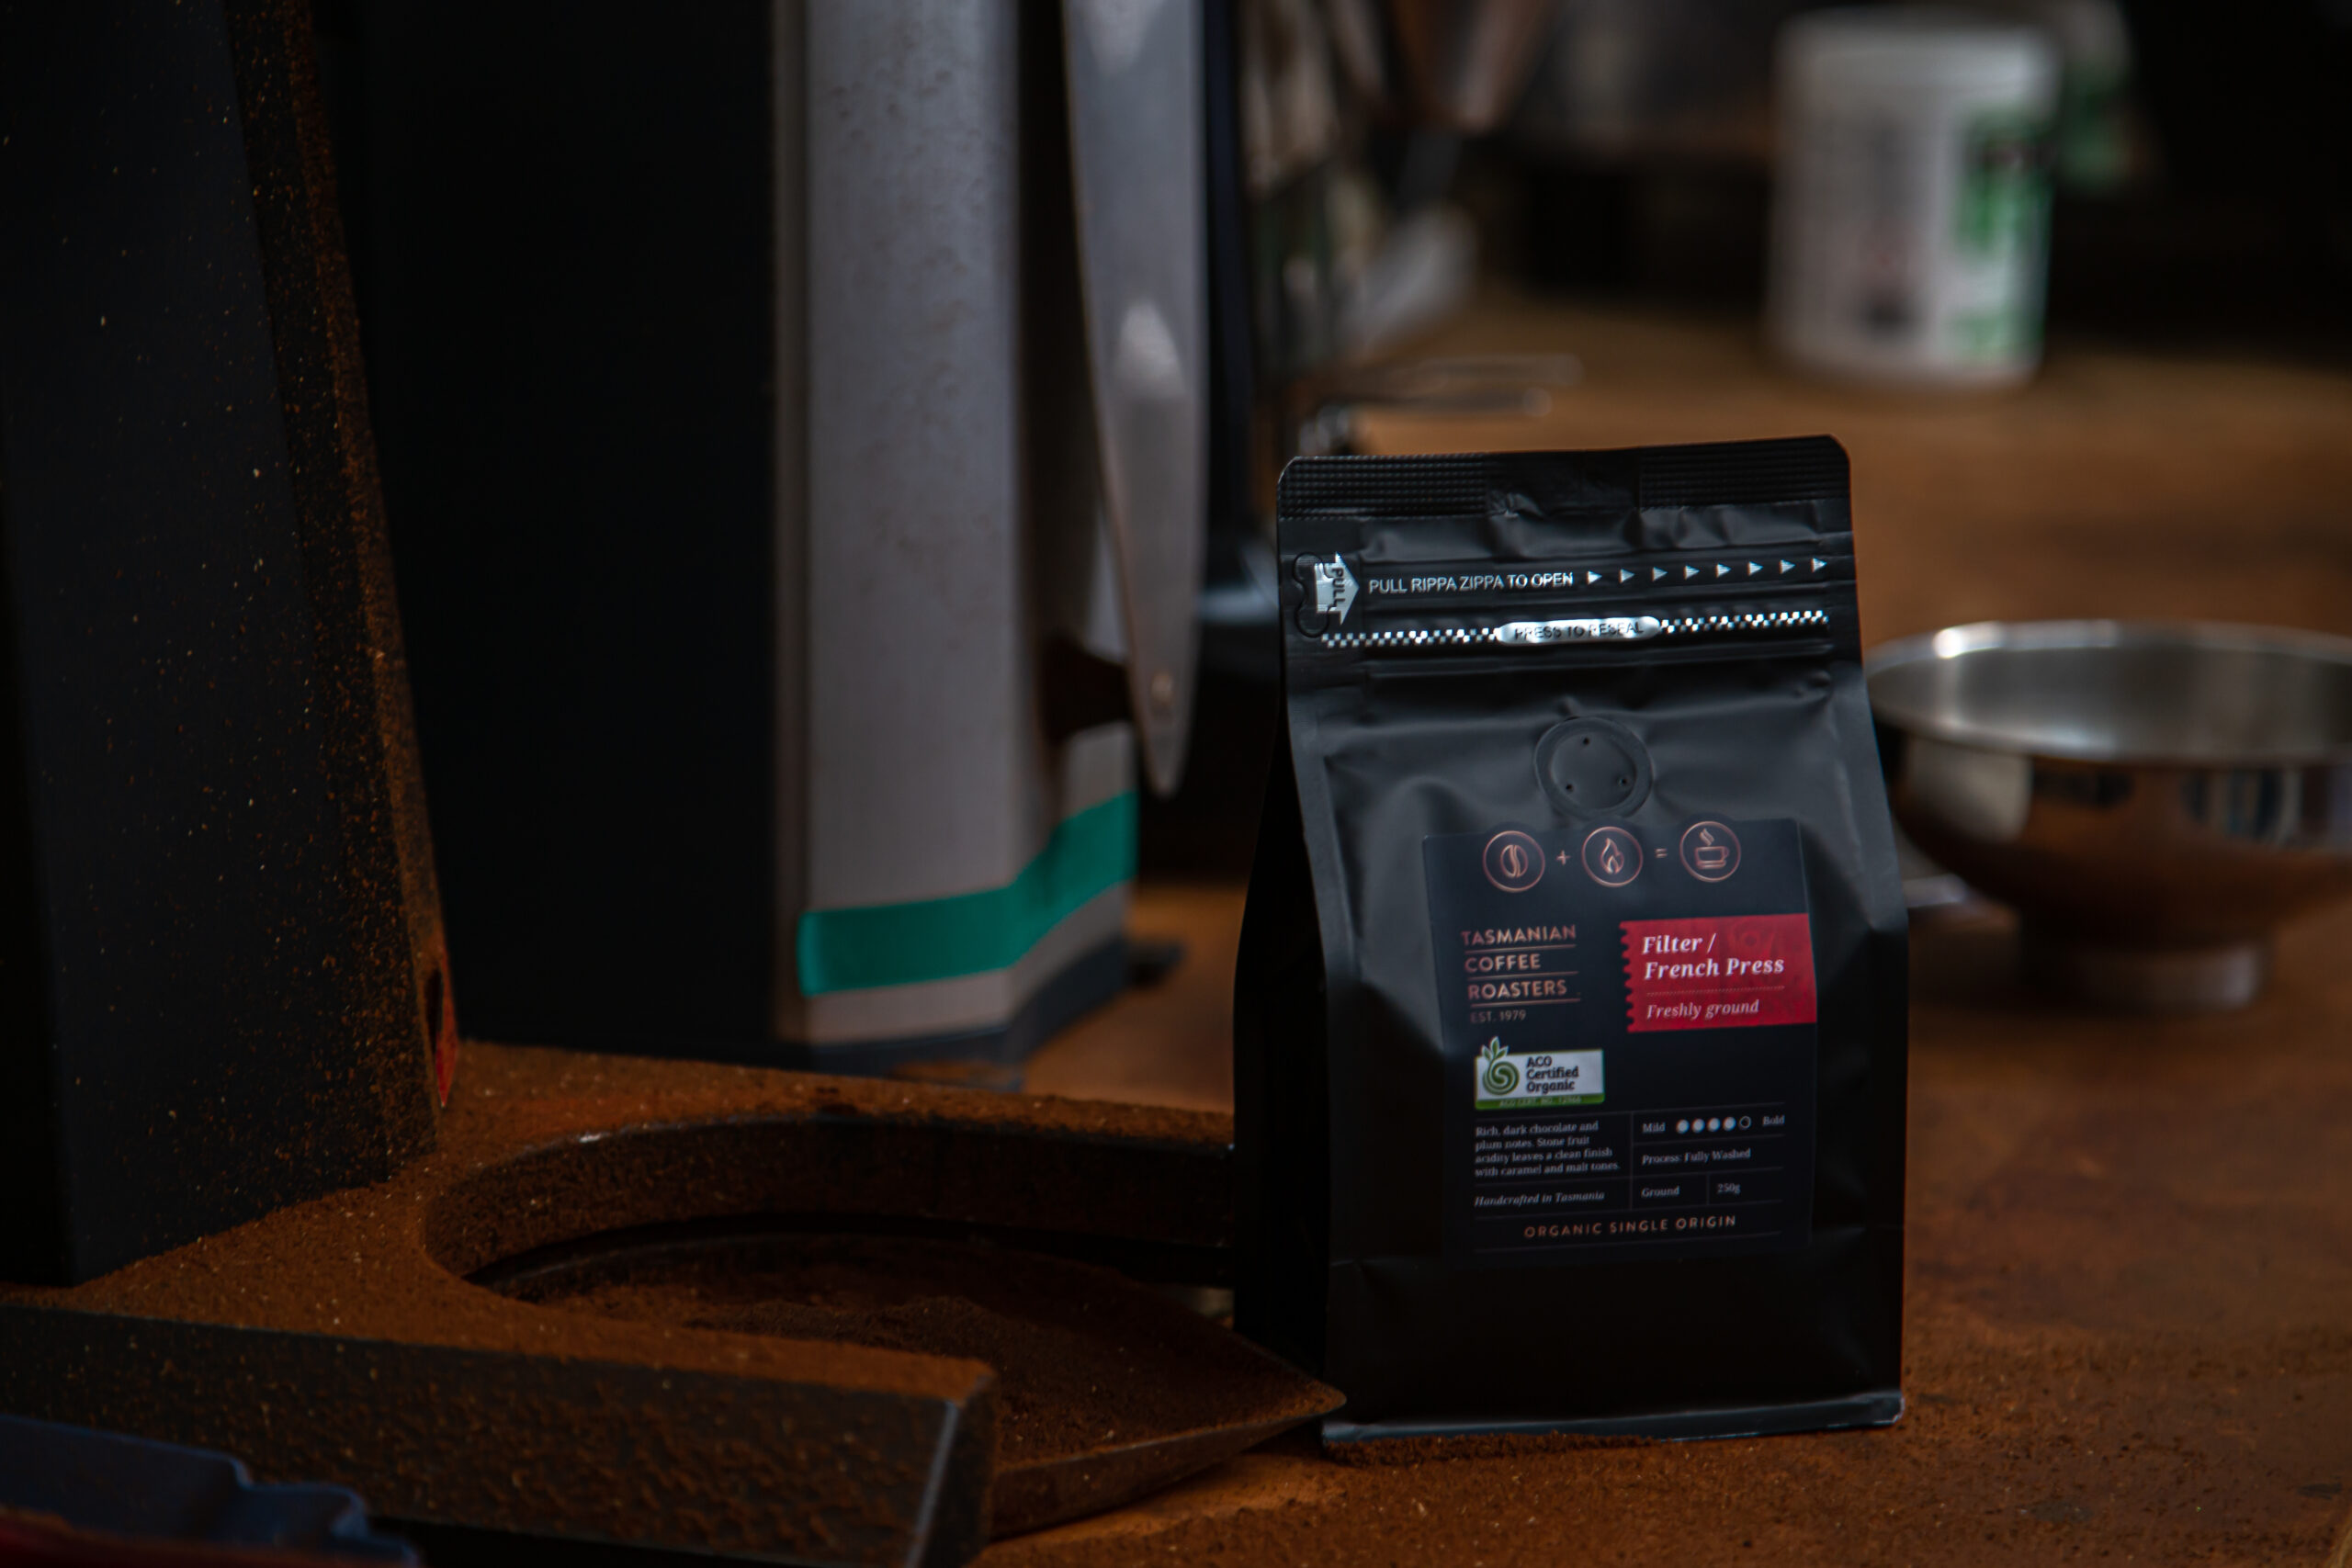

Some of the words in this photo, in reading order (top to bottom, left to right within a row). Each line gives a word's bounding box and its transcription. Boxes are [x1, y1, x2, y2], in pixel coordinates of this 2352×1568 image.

[1332, 568, 1346, 607] PULL
[1369, 579, 1408, 594] PULL
[1411, 576, 1455, 592] RIPPA
[1459, 575, 1504, 592] ZIPPA
[1507, 573, 1529, 589] TO
[1531, 572, 1574, 588] OPEN
[1514, 626, 1562, 639] PRESS
[1566, 625, 1584, 637] TO
[1588, 622, 1645, 637] RESEAL
[1461, 924, 1577, 946] TASMANIAN
[1641, 933, 1703, 955] Filter
[1706, 932, 1717, 953] /
[1464, 953, 1542, 973] COFFEE
[1644, 958, 1720, 980] French
[1725, 957, 1785, 976] Press
[1467, 979, 1567, 1000] ROASTERS
[1470, 1011, 1497, 1024] EST.
[1499, 1010, 1527, 1022] 1979
[1646, 1000, 1702, 1020] Freshly
[1705, 999, 1760, 1021] ground
[1526, 1055, 1553, 1068] ACO
[1526, 1066, 1579, 1080] Certified
[1526, 1078, 1576, 1094] Organic
[1503, 1124, 1528, 1135] dark
[1529, 1122, 1577, 1134] chocolate
[1579, 1120, 1600, 1131] and
[1642, 1122, 1667, 1134] Mild
[1762, 1114, 1785, 1126] Bold
[1476, 1140, 1502, 1152] plum
[1536, 1137, 1566, 1146] Stone
[1567, 1135, 1590, 1145] fruit
[1475, 1152, 1510, 1164] acidity
[1511, 1151, 1544, 1161] leaves
[1545, 1152, 1553, 1160] a
[1555, 1149, 1581, 1159] clean
[1583, 1147, 1613, 1157] finish
[1641, 1154, 1682, 1165] Process:
[1684, 1151, 1710, 1162] Fully
[1712, 1148, 1751, 1161] Washed
[1475, 1167, 1498, 1177] with
[1500, 1165, 1542, 1175] caramel
[1544, 1163, 1564, 1174] and
[1566, 1162, 1589, 1172] malt
[1641, 1185, 1680, 1198] Ground
[1716, 1183, 1742, 1196] 250g
[1474, 1193, 1540, 1207] Handcrafted
[1542, 1193, 1553, 1202] in
[1555, 1190, 1605, 1202] Tasmania
[1523, 1222, 1603, 1237] ORGANIC
[1610, 1219, 1669, 1234] SINGLE
[1675, 1215, 1737, 1231] ORIGIN
